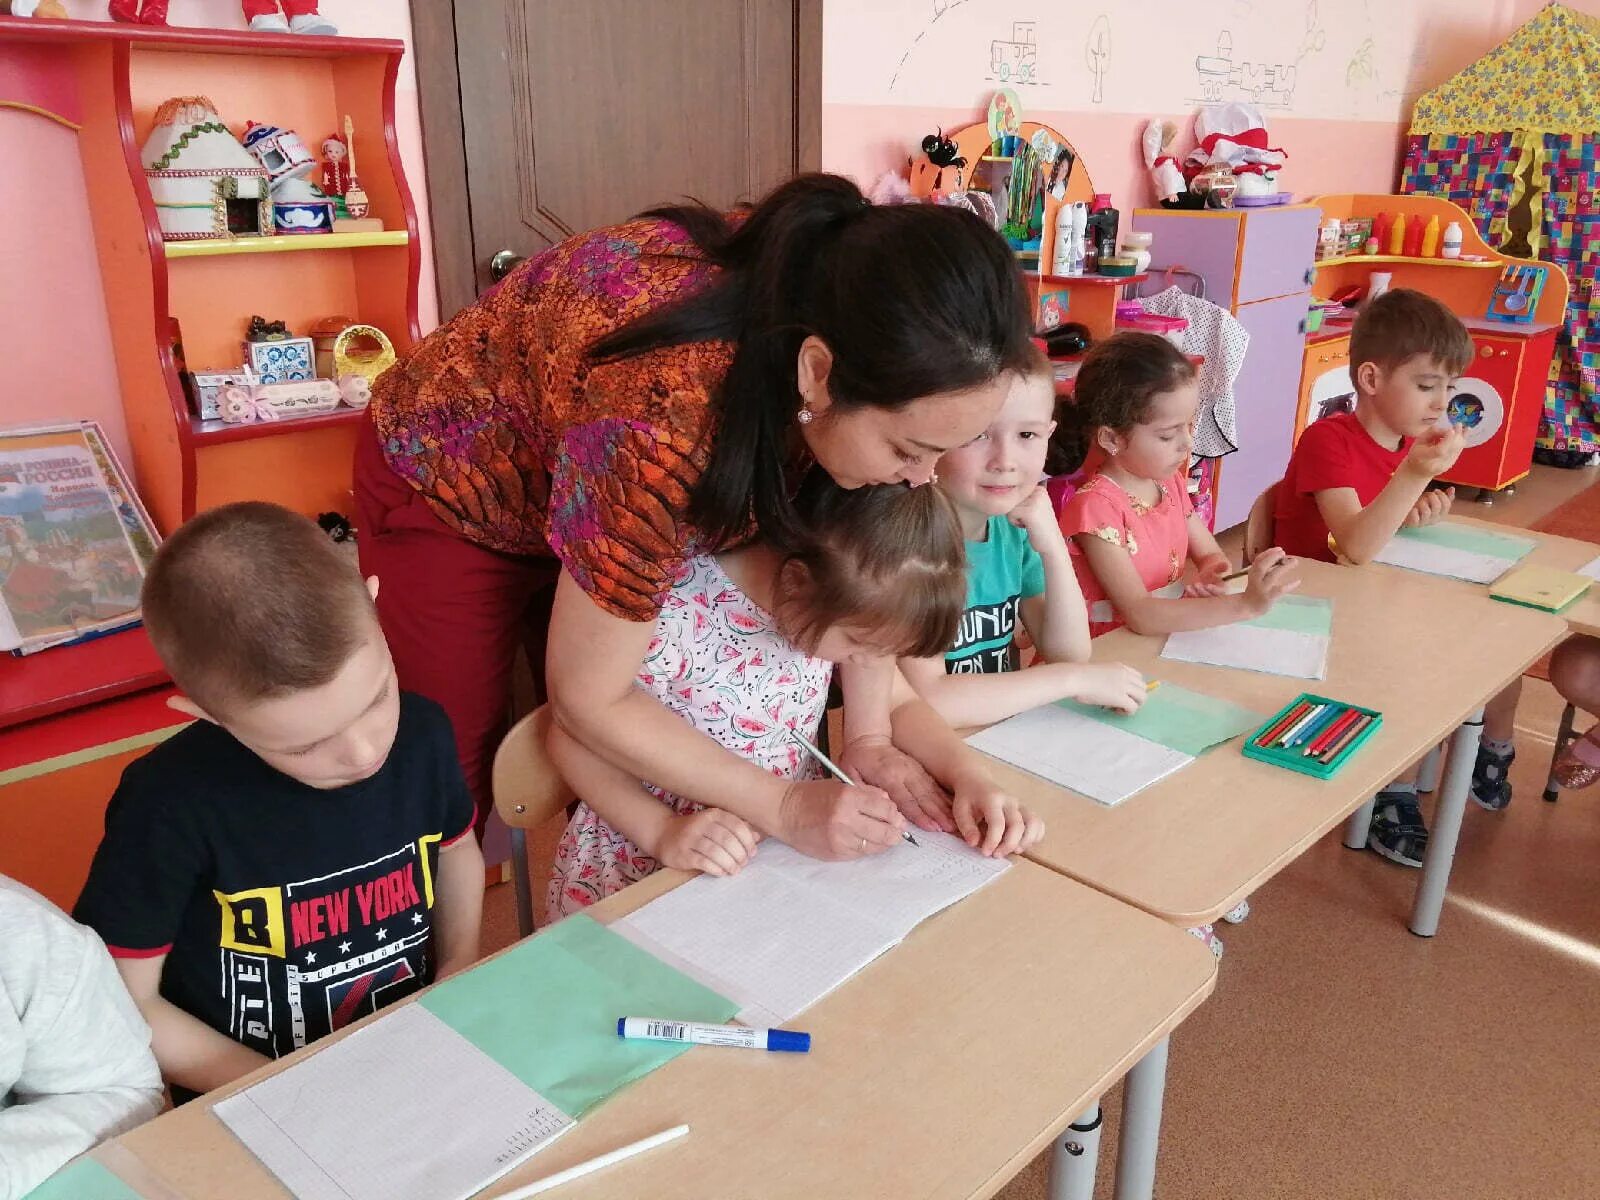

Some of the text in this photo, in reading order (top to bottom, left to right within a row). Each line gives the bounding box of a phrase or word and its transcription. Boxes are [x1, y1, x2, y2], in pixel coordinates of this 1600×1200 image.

[24, 466, 94, 484] РОССИЯ
[290, 863, 420, 949] NEW YORK
[302, 942, 401, 981] SUPERIOR
